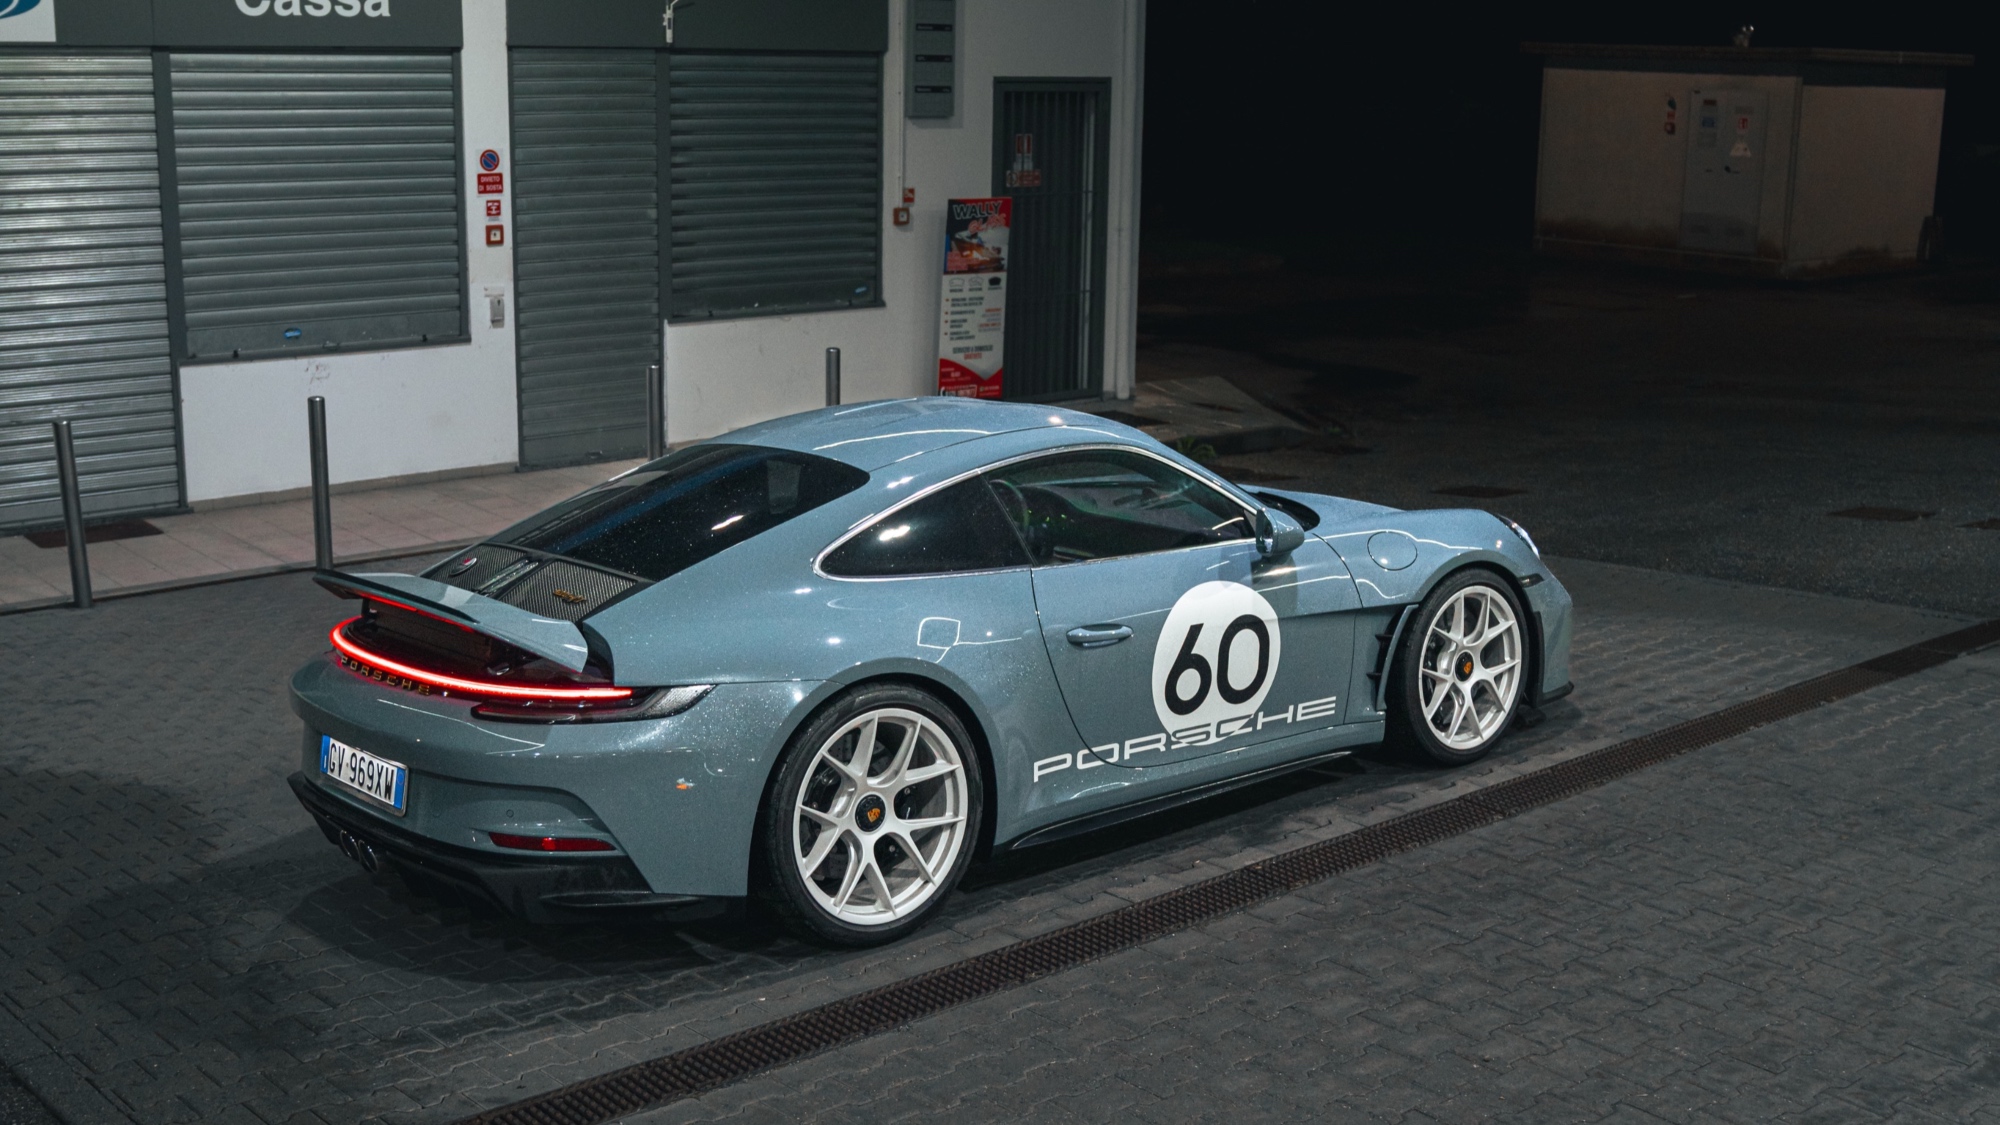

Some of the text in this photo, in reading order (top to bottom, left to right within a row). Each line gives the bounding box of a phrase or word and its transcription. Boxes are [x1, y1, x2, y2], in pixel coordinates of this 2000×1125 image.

[486, 184, 502, 192] SOSTA
[952, 200, 1003, 220] WALLY
[341, 655, 430, 695] PORSCHE
[1164, 614, 1270, 716] 60
[1033, 696, 1337, 783] PORSCHE
[329, 743, 395, 801] GV 969XW
